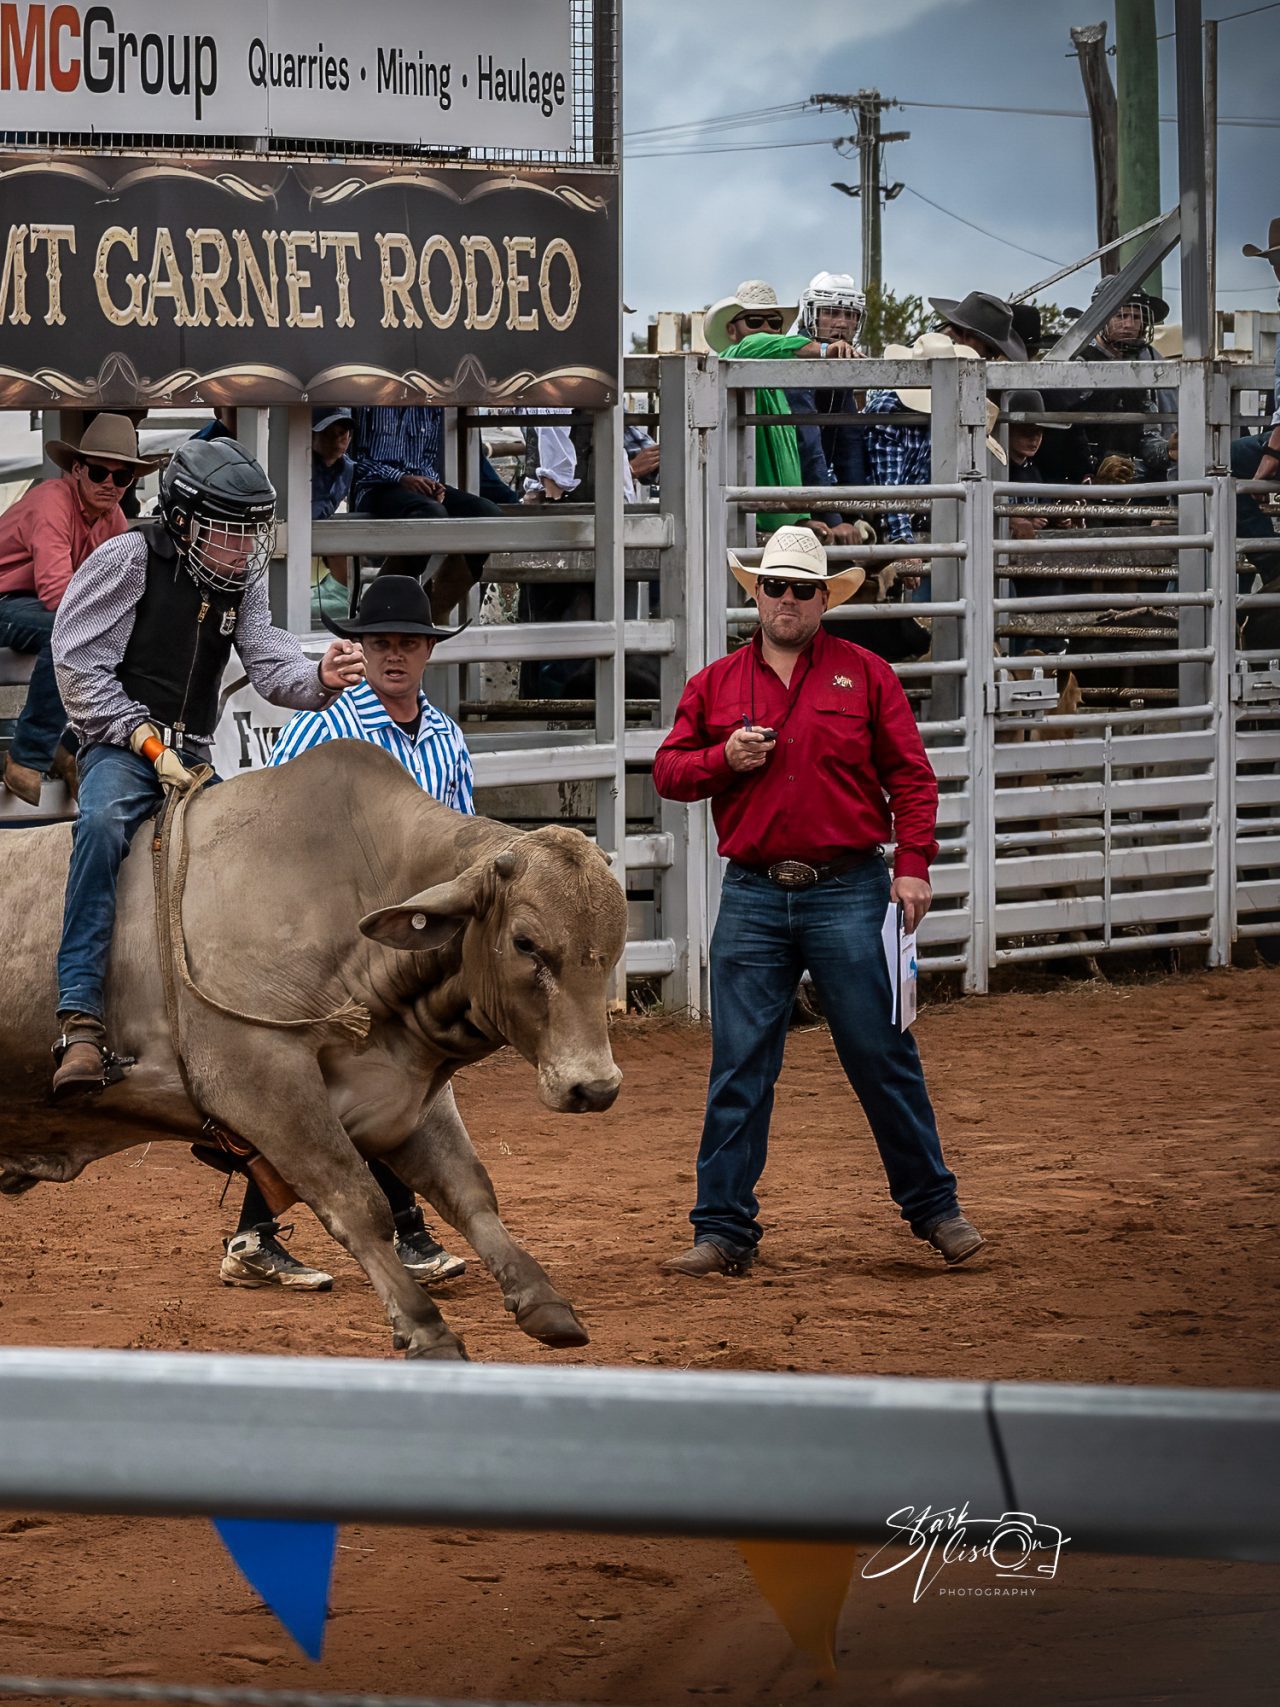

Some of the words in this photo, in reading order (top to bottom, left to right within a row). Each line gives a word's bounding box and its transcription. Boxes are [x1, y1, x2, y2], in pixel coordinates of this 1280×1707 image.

[1, 2, 217, 120] MCGroup
[248, 38, 350, 91] Quarries
[377, 47, 451, 110] Mining
[477, 54, 566, 118] Haulage
[93, 225, 361, 328] GARNET
[374, 231, 582, 332] RODEO
